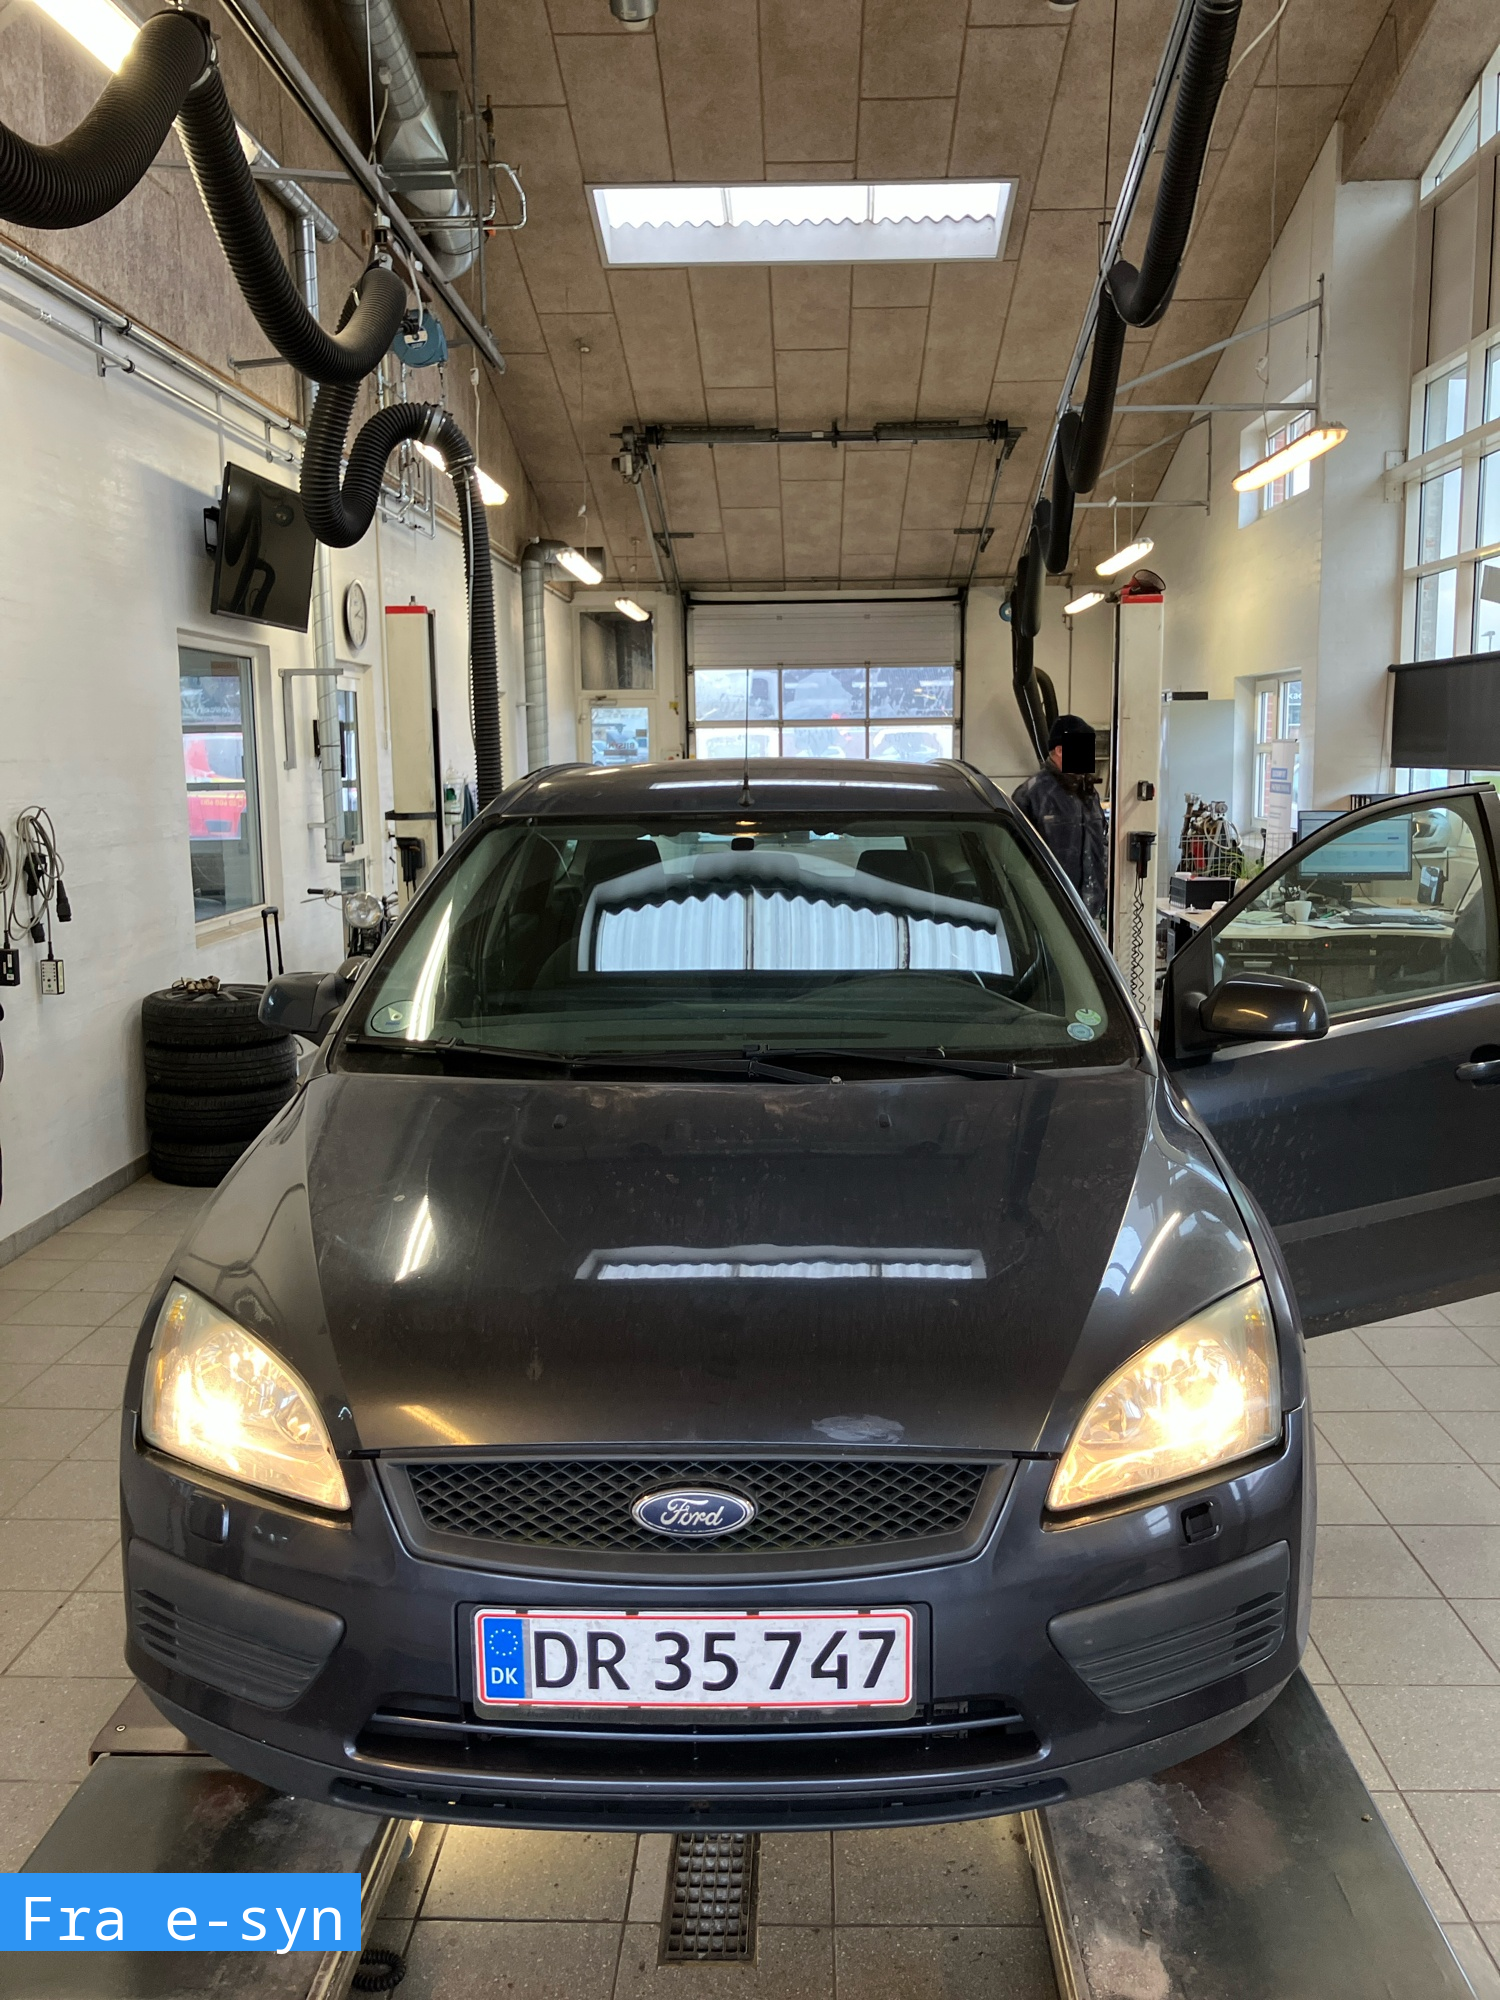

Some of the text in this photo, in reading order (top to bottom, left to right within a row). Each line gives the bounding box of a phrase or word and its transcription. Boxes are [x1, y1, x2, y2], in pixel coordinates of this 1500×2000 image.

[660, 1498, 725, 1526] Ford
[533, 1629, 897, 1692] DR 35 747
[490, 1666, 519, 1686] DK
